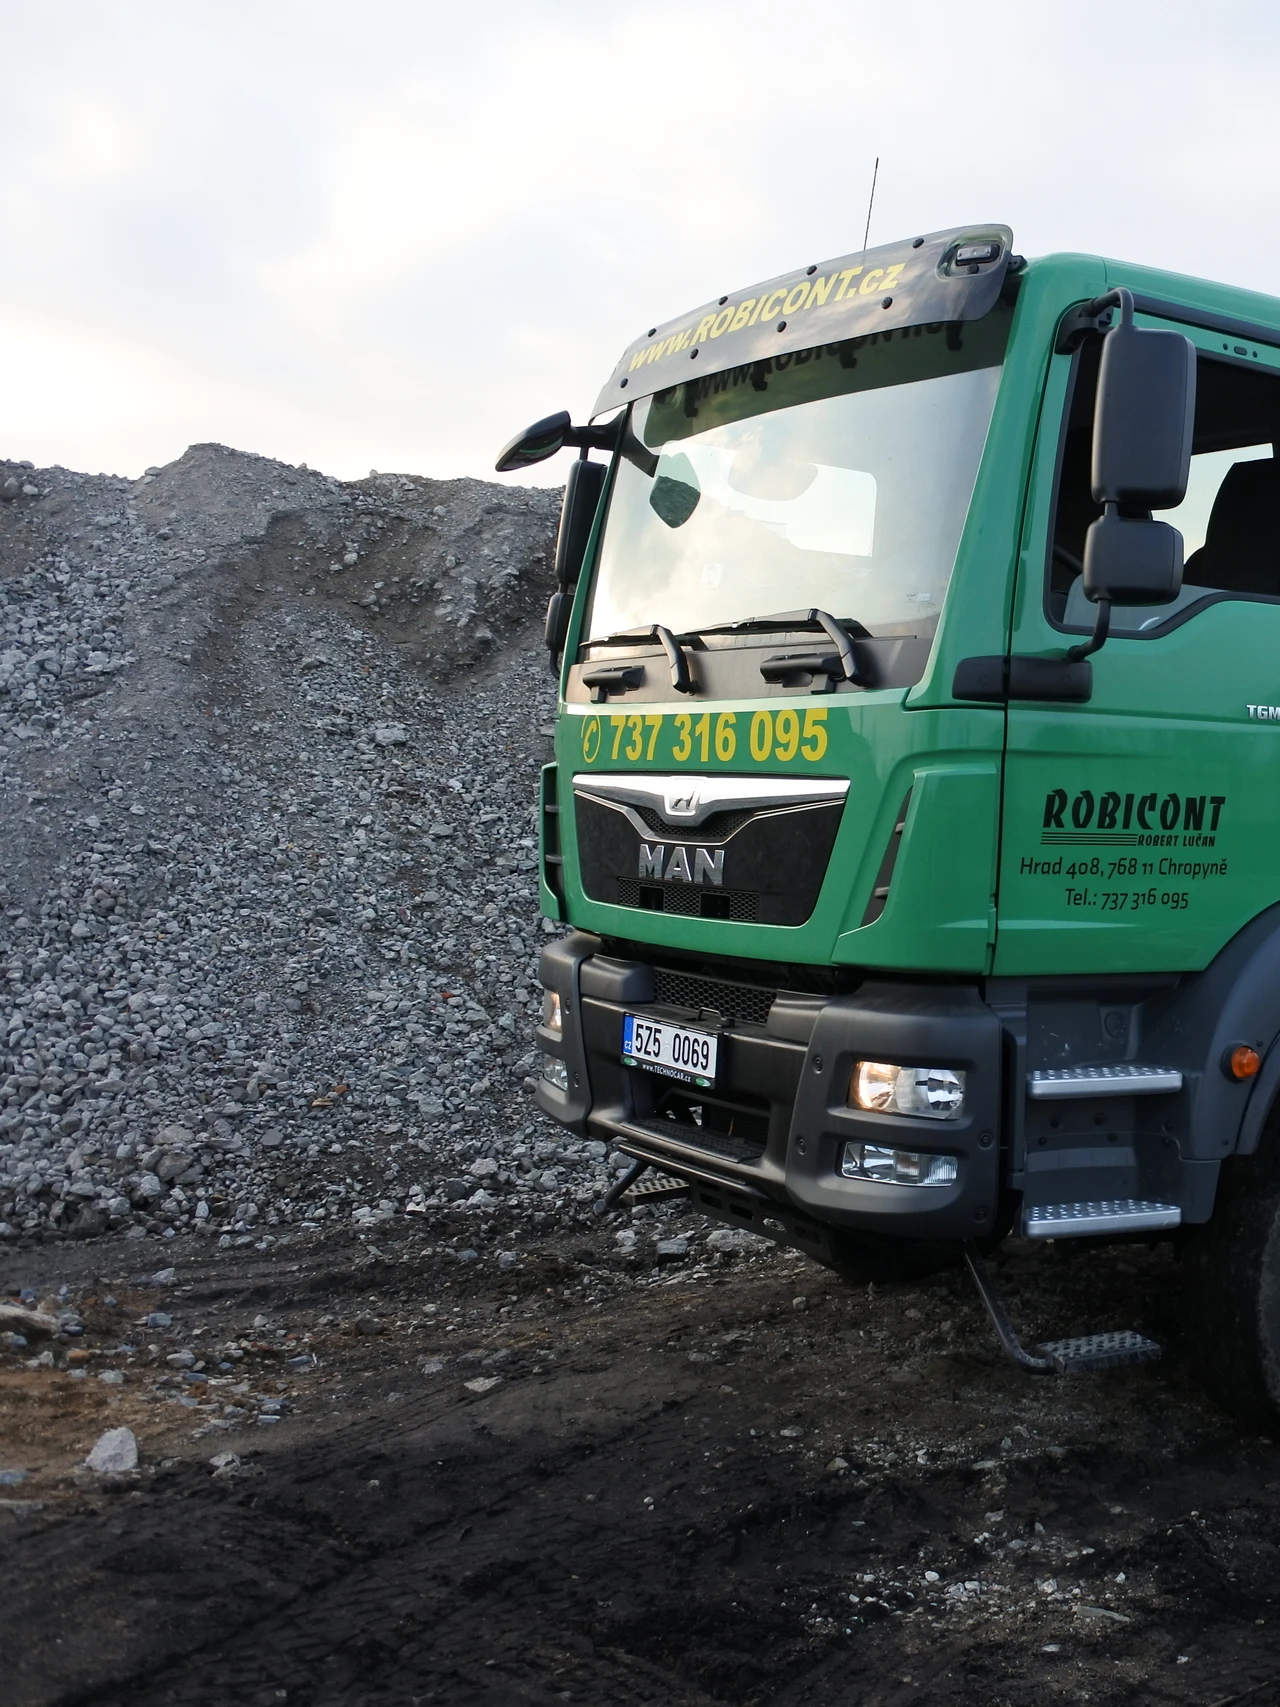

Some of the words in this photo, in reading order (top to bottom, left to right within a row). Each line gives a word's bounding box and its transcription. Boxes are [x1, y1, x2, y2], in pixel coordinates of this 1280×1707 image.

[627, 263, 906, 373] www.ROBICONT.cz
[610, 714, 663, 761] 737
[672, 711, 737, 762] 316
[750, 707, 829, 762] 095
[1042, 788, 1226, 831] ROBICONT
[1137, 833, 1179, 847] ROBERT
[1183, 832, 1216, 848] LUČAN
[638, 843, 725, 886] MAN
[1020, 857, 1062, 875] Hrad
[1066, 858, 1104, 879] 408,
[1108, 858, 1137, 880] 768
[1142, 862, 1154, 875] 11
[1159, 858, 1228, 880] Chropyně
[1065, 888, 1097, 906] Tel.:
[1101, 892, 1128, 910] 737
[1131, 888, 1157, 910] 316
[1161, 892, 1189, 910] 095
[624, 1040, 632, 1050] CZ
[635, 1023, 662, 1058] 5Z5
[672, 1033, 710, 1071] 0069
